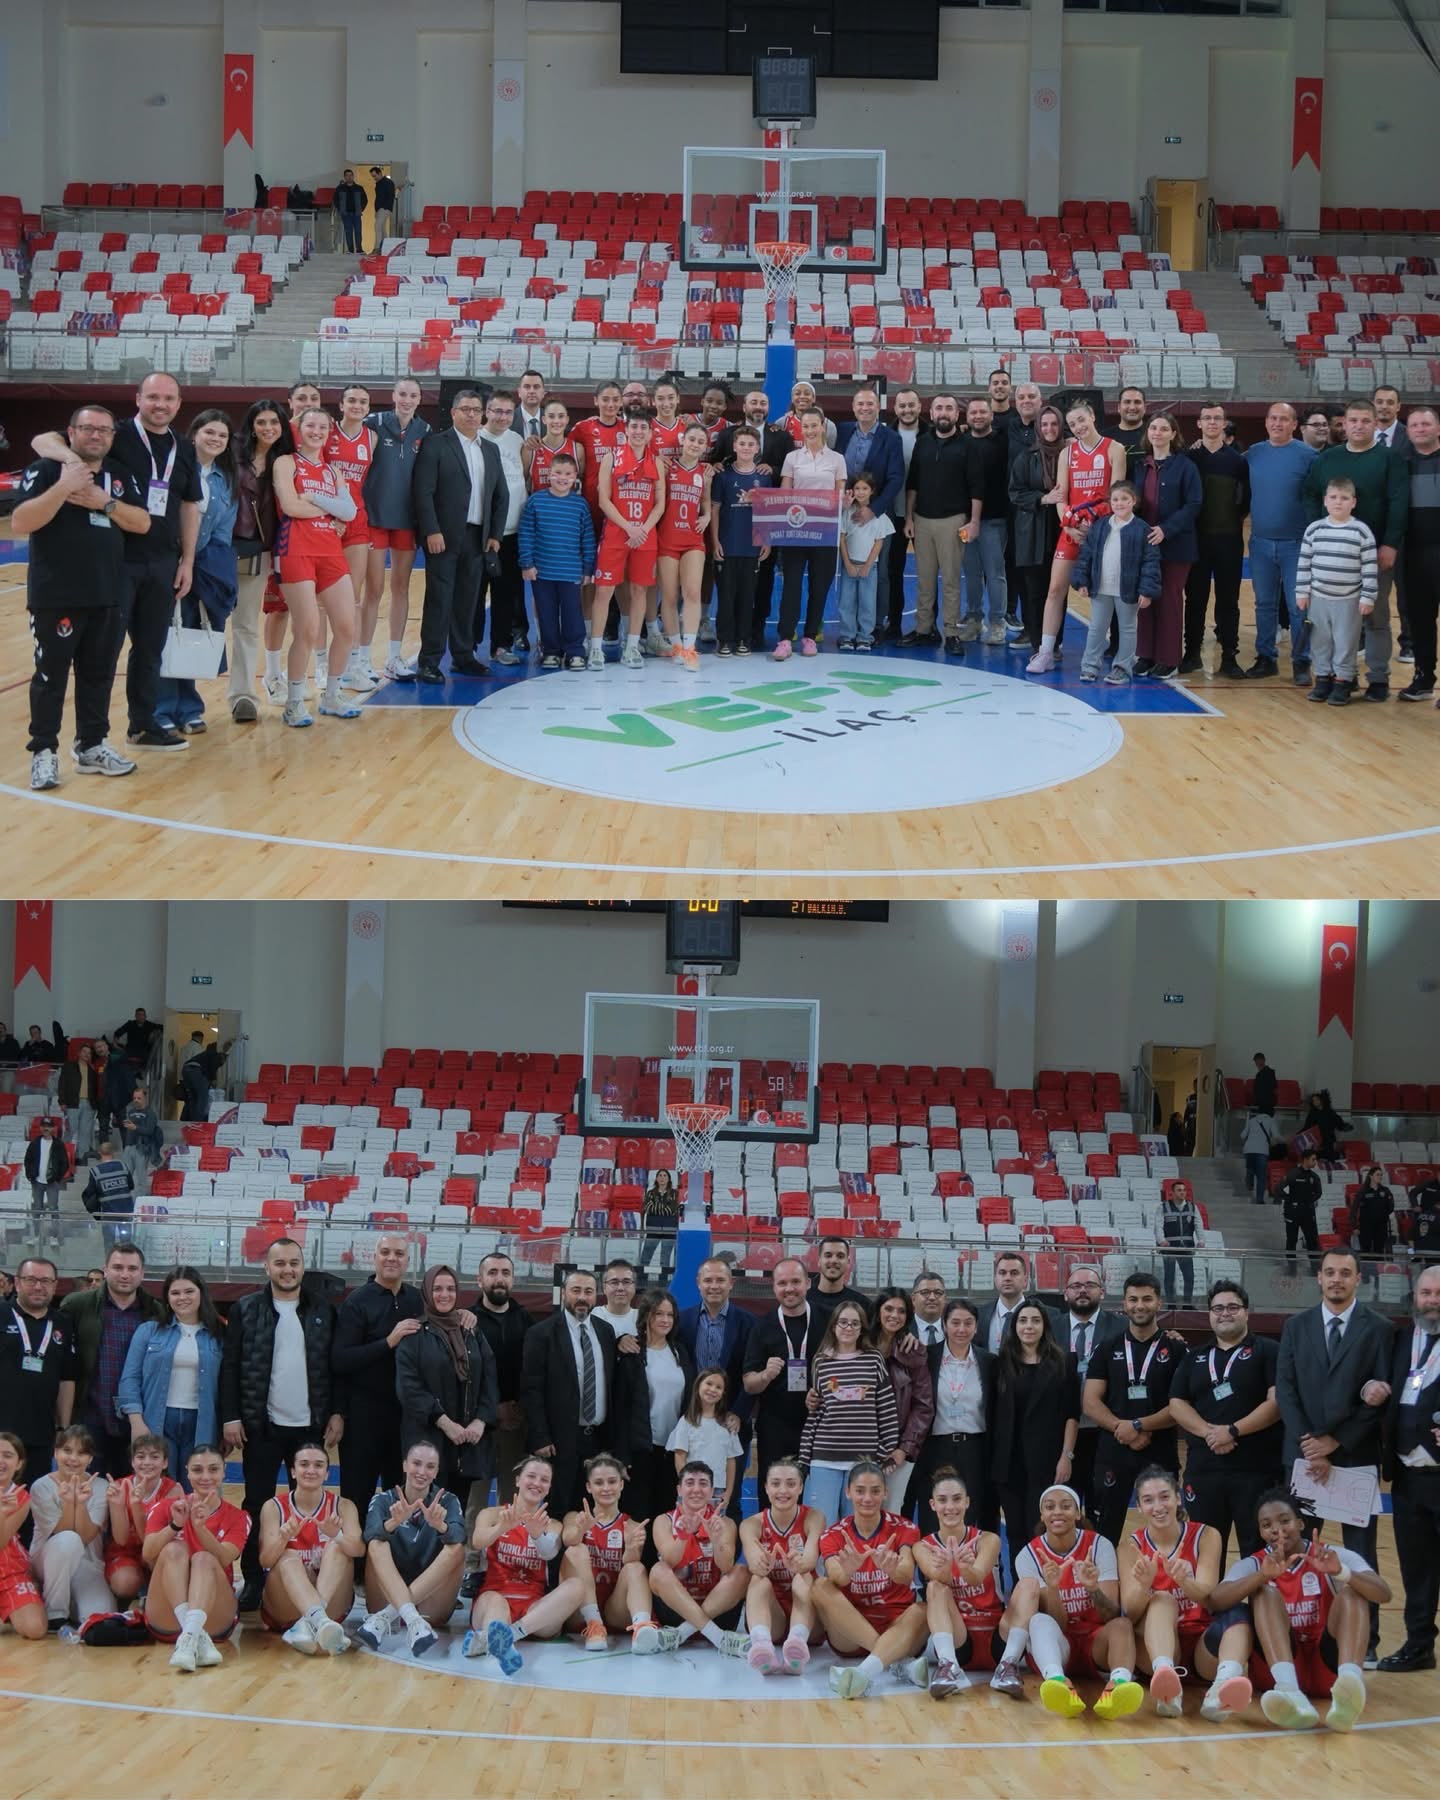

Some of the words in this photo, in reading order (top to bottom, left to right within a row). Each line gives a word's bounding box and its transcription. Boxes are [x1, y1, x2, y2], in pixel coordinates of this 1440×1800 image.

[628, 502, 643, 519] 18
[679, 503, 688, 519] 0
[542, 671, 942, 747] VEFA
[773, 710, 917, 743] İLAÇ
[791, 902, 805, 913] 21
